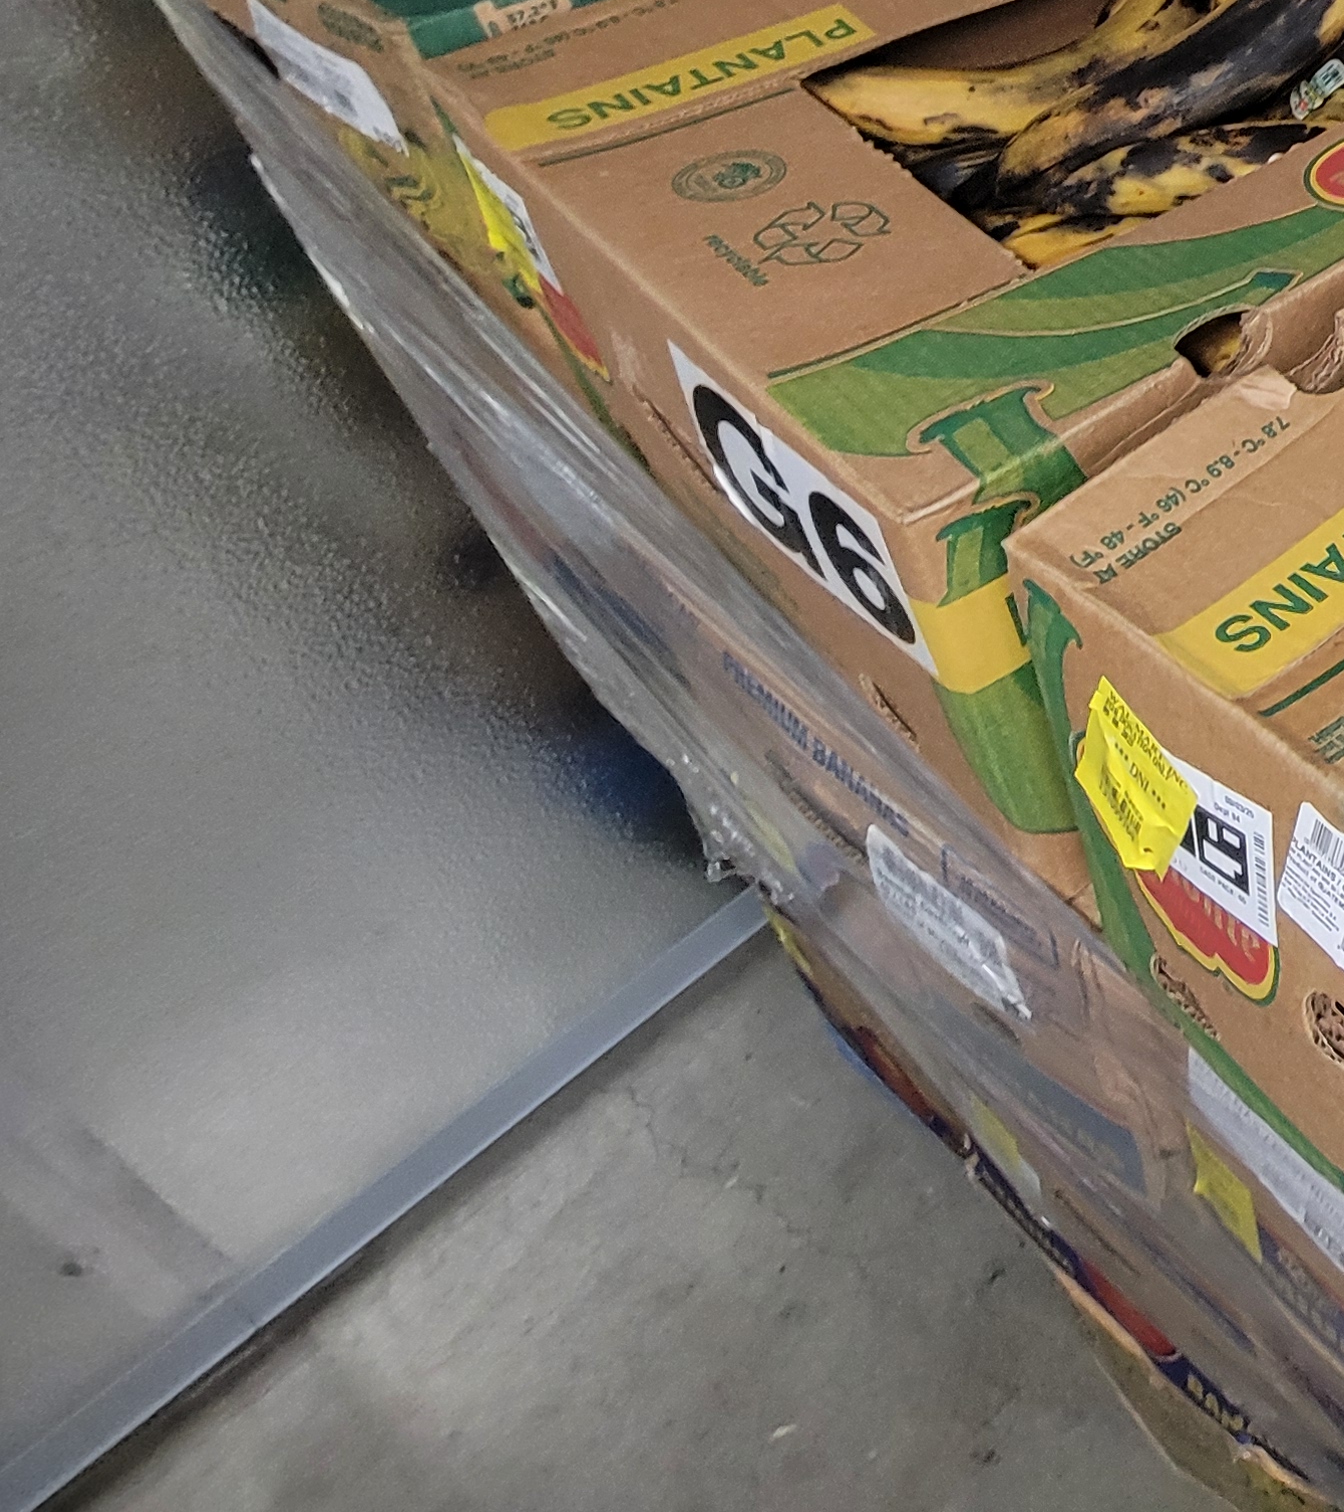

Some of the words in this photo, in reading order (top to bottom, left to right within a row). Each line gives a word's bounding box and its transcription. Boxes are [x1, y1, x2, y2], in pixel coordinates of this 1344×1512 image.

[546, 16, 860, 130] PLANTAINS
[1260, 415, 1291, 439] 7.8
[1240, 438, 1266, 454] °C
[1205, 454, 1235, 478] 8.9
[1184, 478, 1211, 494] °C
[1155, 486, 1187, 513] (46
[692, 384, 916, 645] G6
[1137, 511, 1160, 529] °F
[1099, 529, 1125, 551] 48
[1115, 522, 1183, 570] STORE
[1068, 549, 1105, 575] °F)
[1092, 562, 1119, 586] AT
[1128, 760, 1149, 793] DNI
[1285, 836, 1342, 882] PLANTAINS
